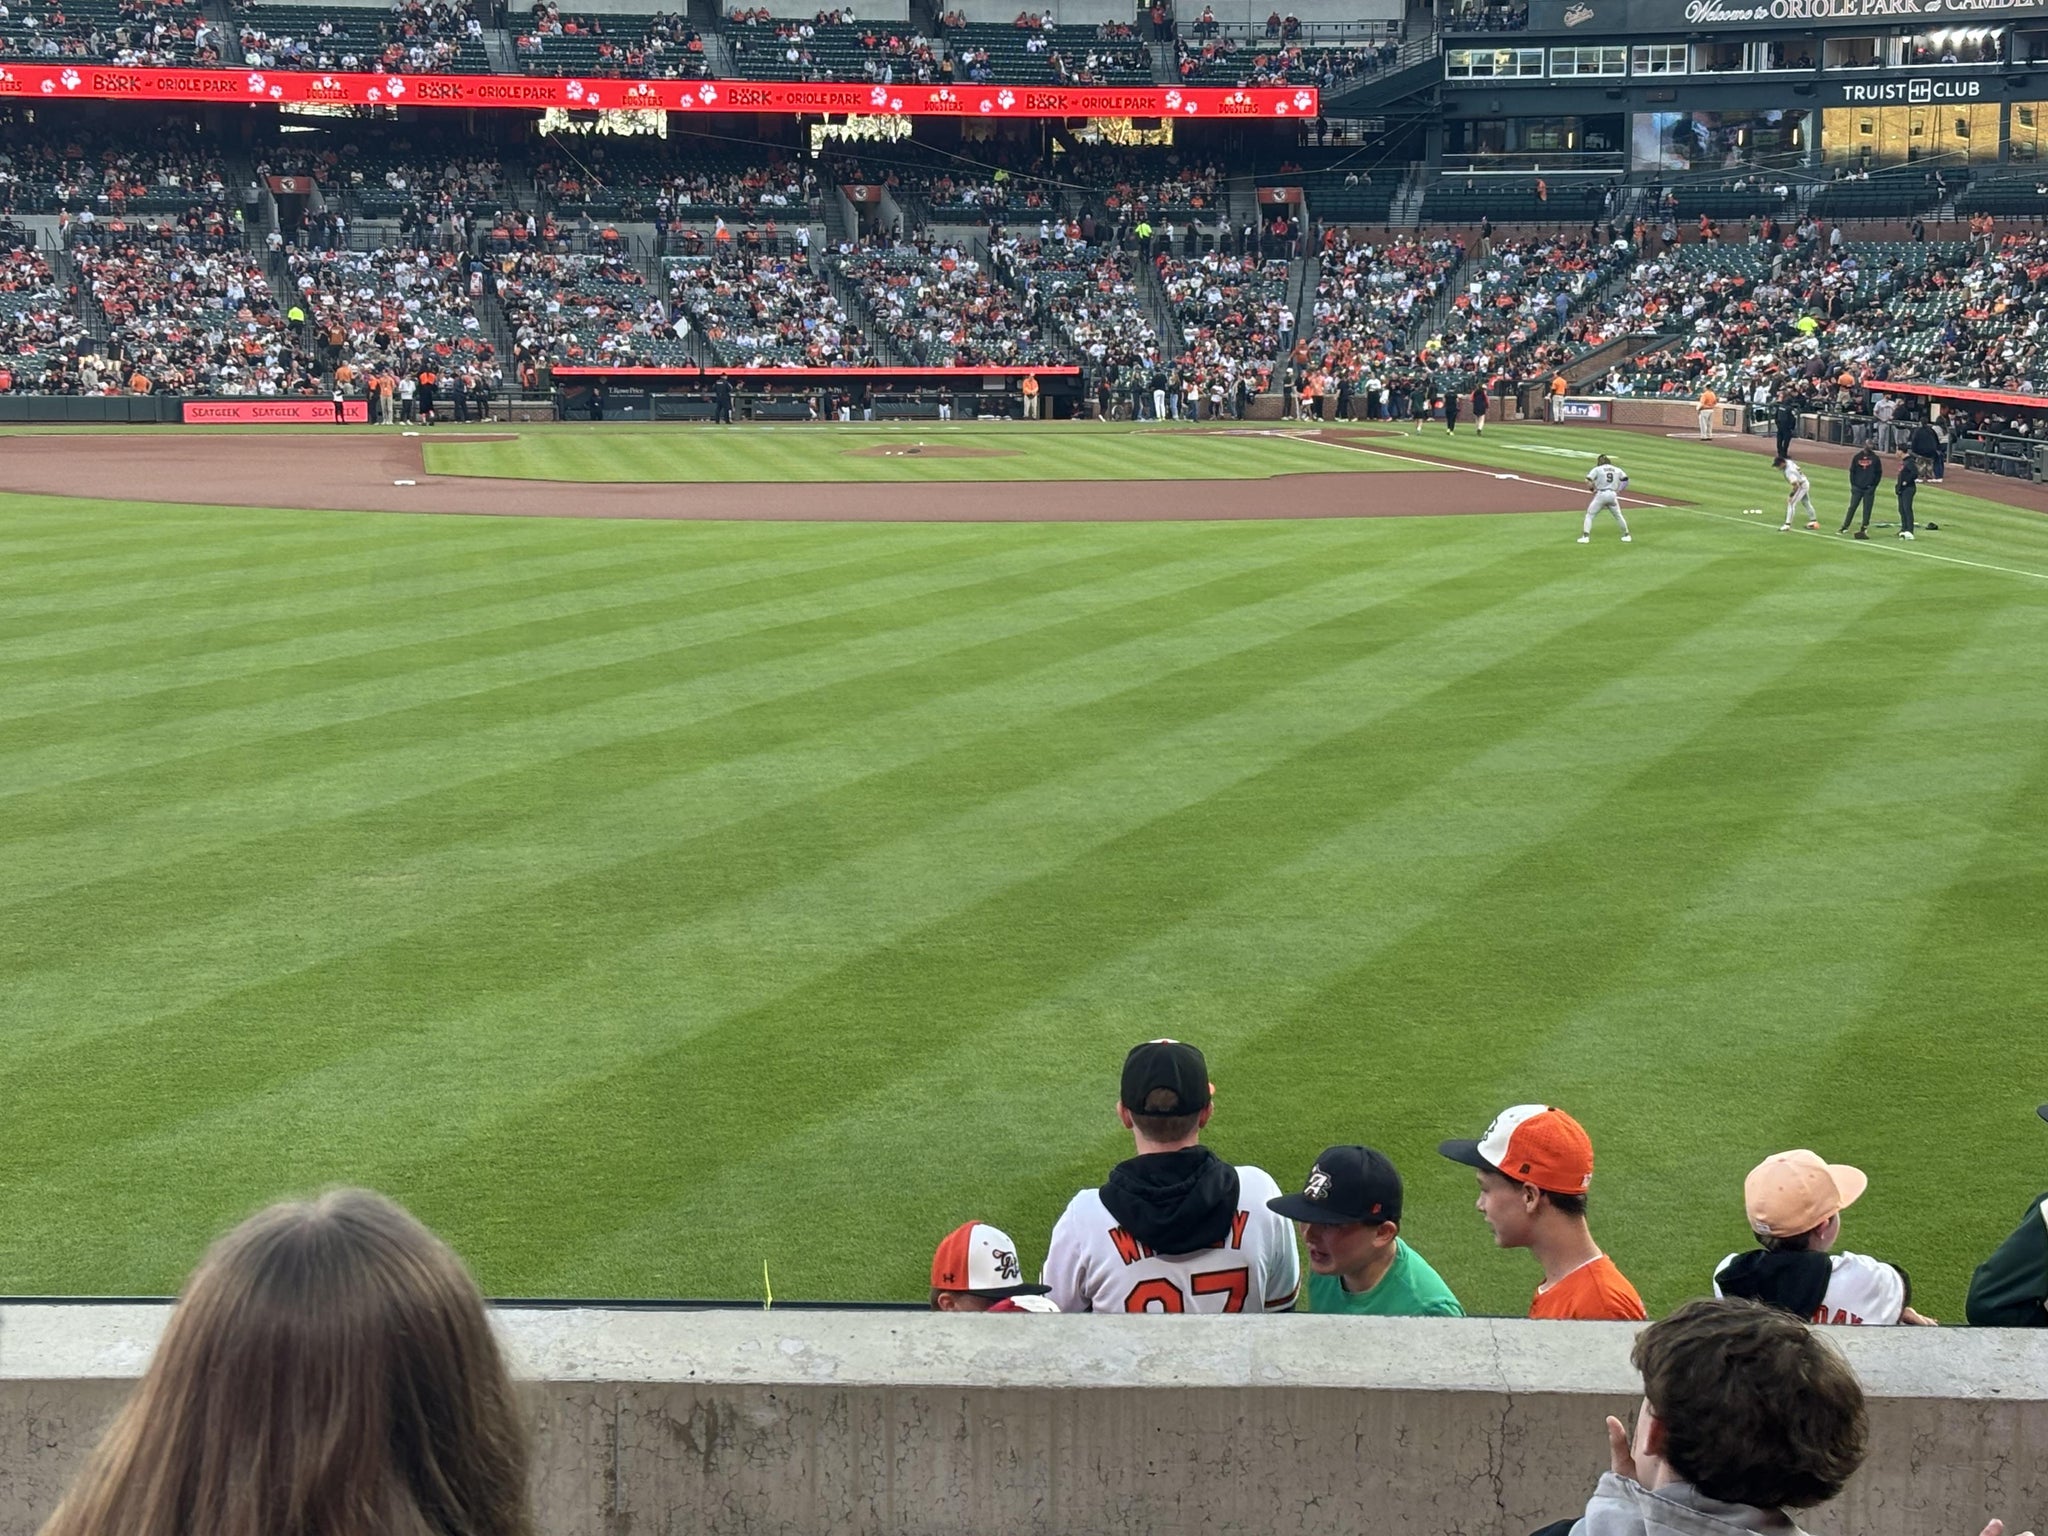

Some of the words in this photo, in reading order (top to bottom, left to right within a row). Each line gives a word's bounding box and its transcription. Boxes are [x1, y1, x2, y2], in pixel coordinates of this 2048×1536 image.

[1684, 0, 1753, 23] Welcome
[1753, 6, 1769, 20] to
[1770, 0, 1858, 18] ORIOLE
[1860, 0, 1922, 15] PARK
[157, 78, 201, 92] ORIOLE
[203, 79, 238, 93] PARK
[1843, 84, 1906, 100] TRUIST
[1933, 81, 1980, 97] CLUB
[478, 86, 521, 99] ORIOLE
[523, 87, 557, 100] PARK
[786, 92, 827, 104] ORIOLE
[830, 92, 862, 105] PARK
[622, 95, 663, 106] DOGSTERS
[924, 101, 963, 111] DOGSTERS
[1081, 97, 1122, 109] ORIOLE
[1124, 97, 1156, 109] PARK
[1218, 104, 1259, 114] DOGSTERS
[192, 407, 240, 418] SEATGEEK
[252, 407, 300, 418] SEATGEEK
[312, 407, 359, 418] SEATEK
[1606, 472, 1614, 483] 9
